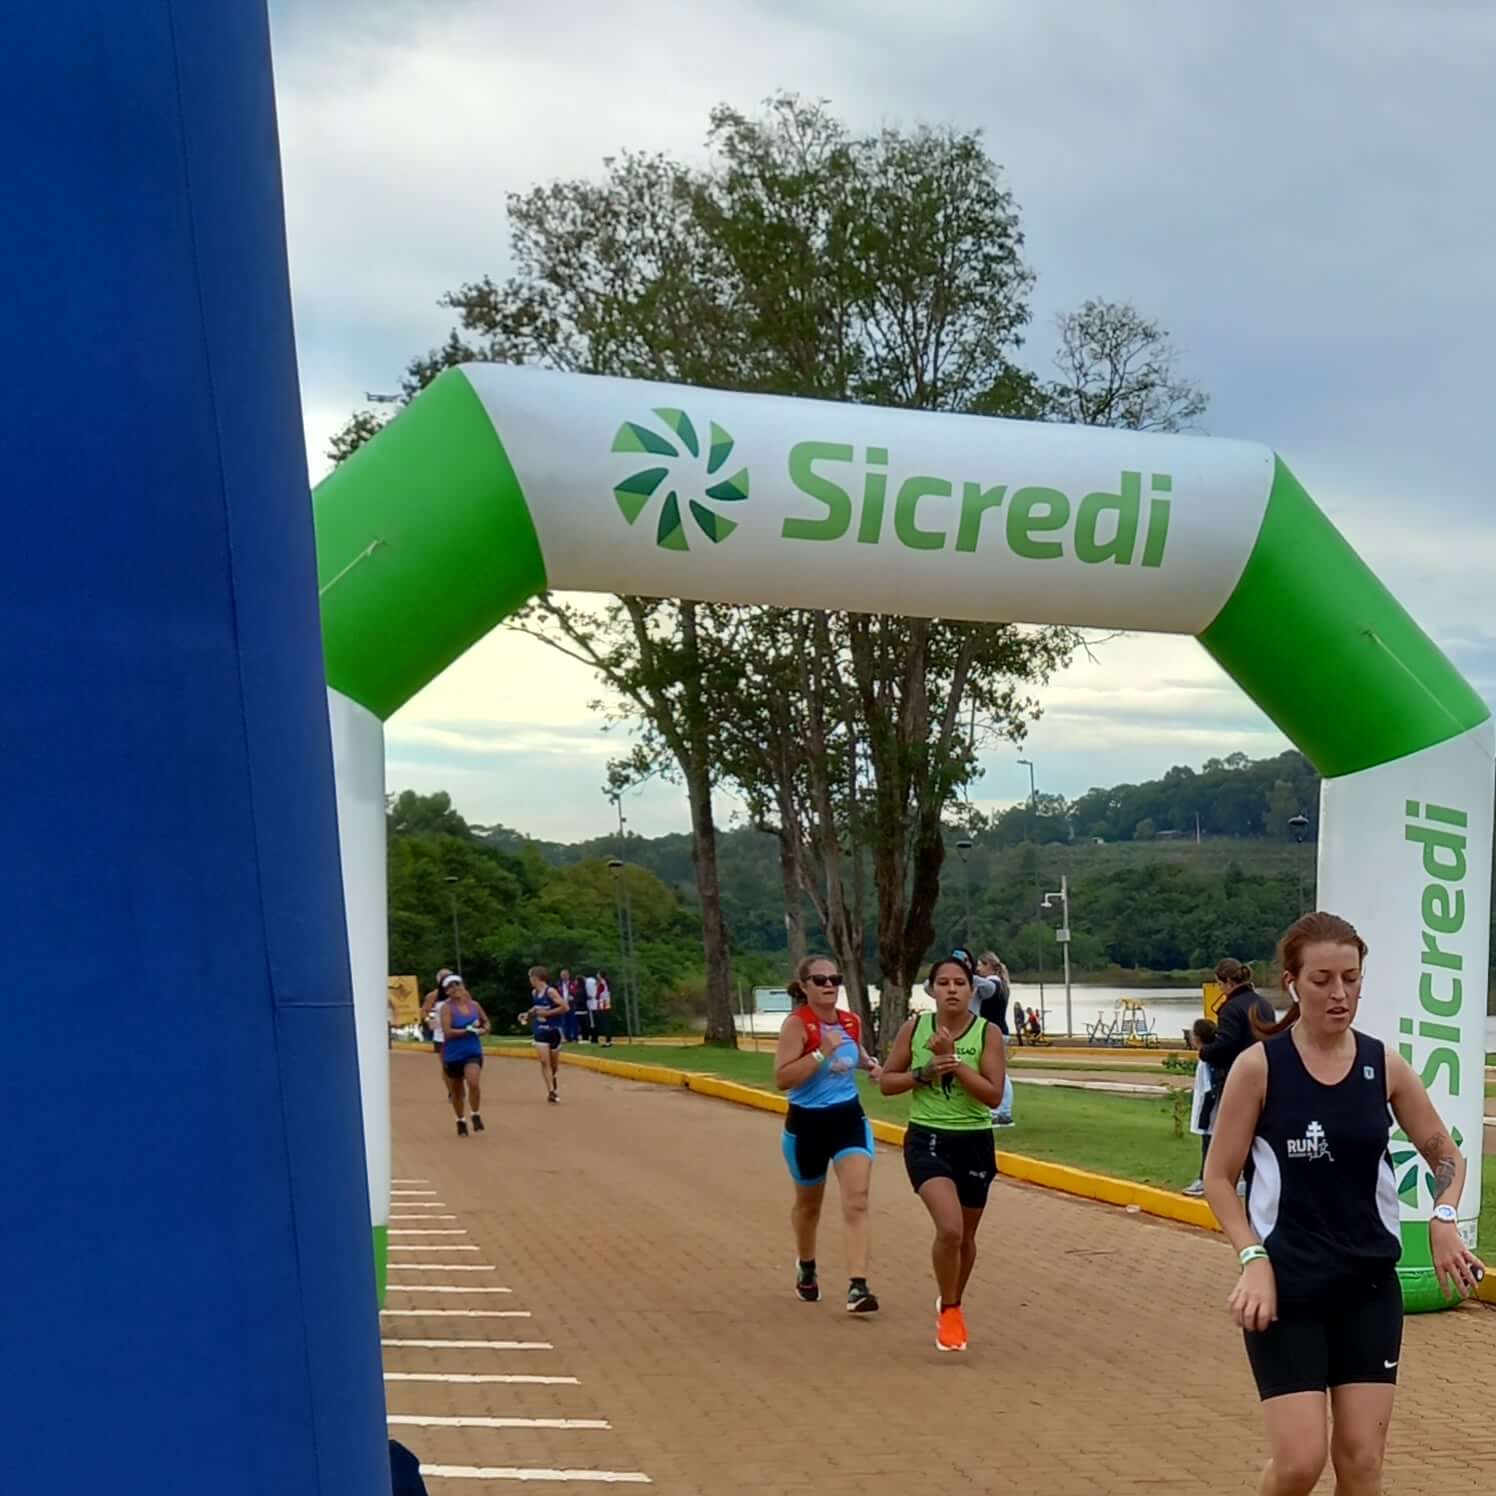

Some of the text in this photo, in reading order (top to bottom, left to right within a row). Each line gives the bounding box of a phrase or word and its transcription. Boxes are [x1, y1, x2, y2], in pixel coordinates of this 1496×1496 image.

[781, 440, 1173, 569] Sicredi
[1399, 798, 1468, 1098] Sicredi
[1286, 1138, 1318, 1153] RUN
